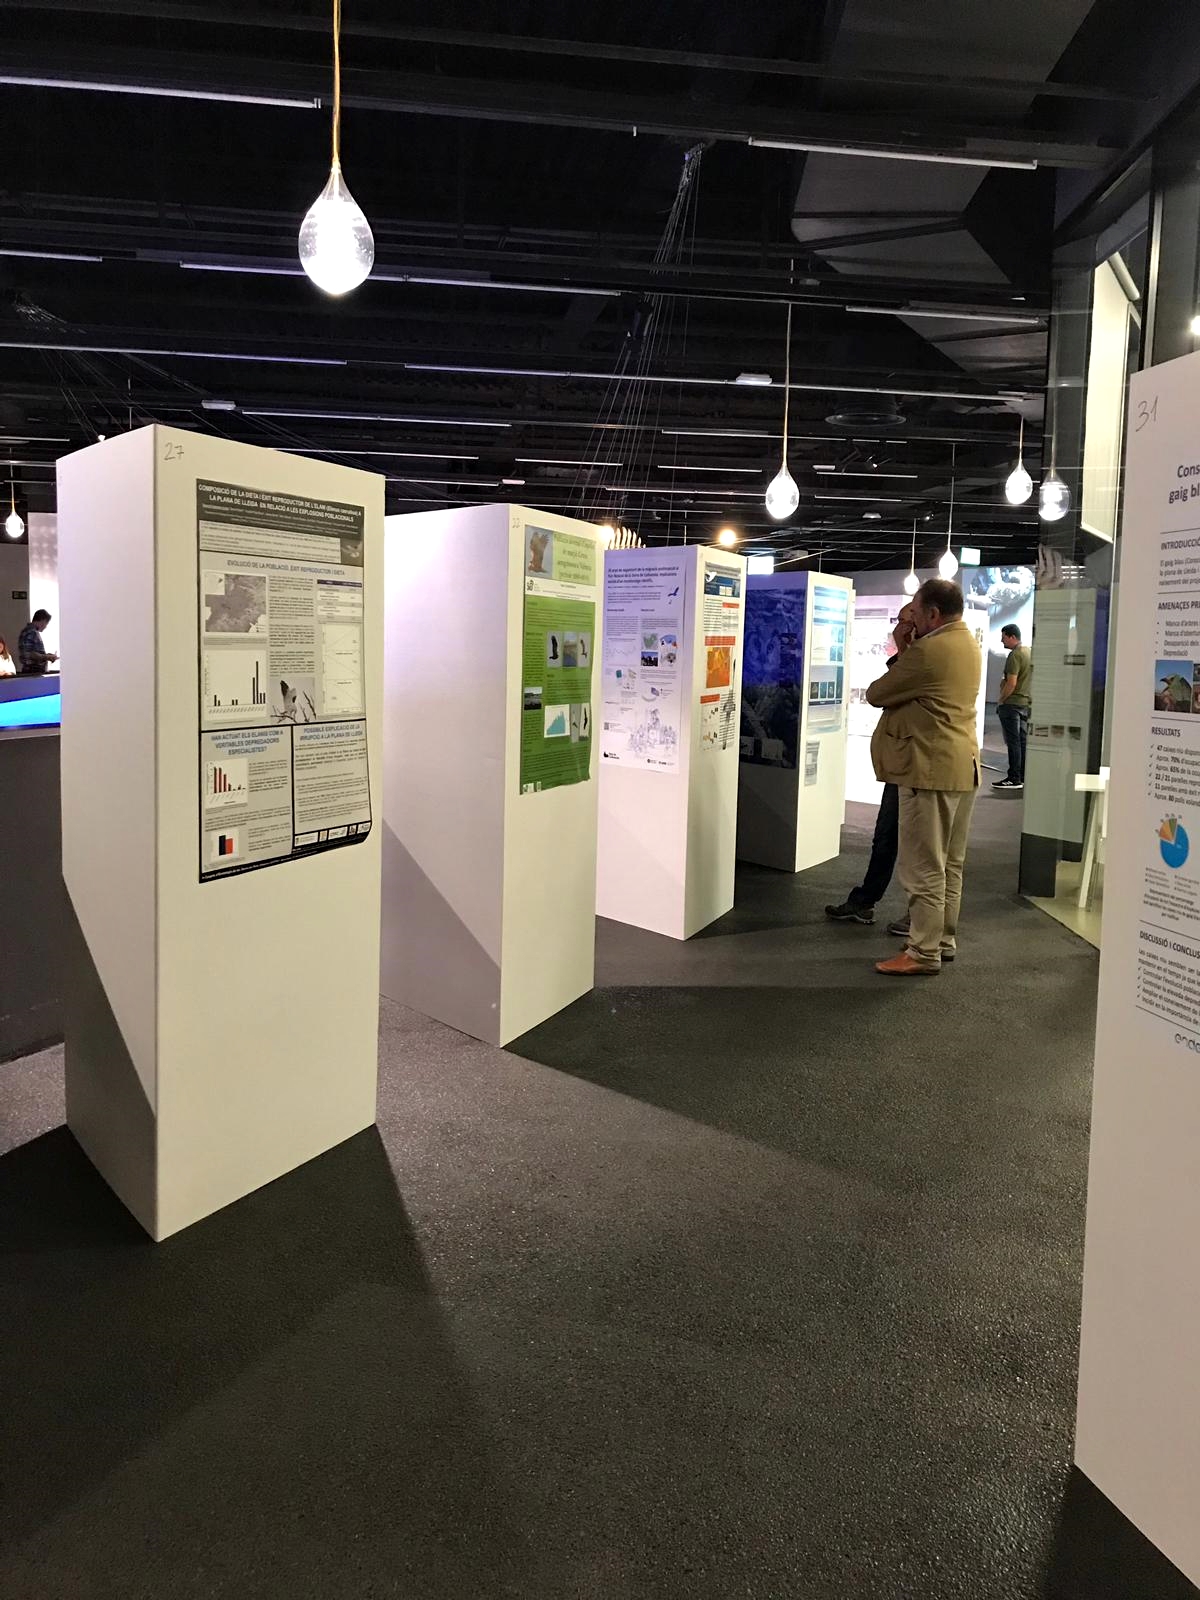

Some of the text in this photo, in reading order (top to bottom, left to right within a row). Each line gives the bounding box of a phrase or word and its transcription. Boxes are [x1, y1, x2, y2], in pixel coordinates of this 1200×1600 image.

[164, 442, 184, 461] 27
[272, 496, 304, 506] REPRODUCTOR
[1169, 486, 1188, 504] gaig
[1158, 601, 1190, 611] AMENAÇES
[1152, 726, 1180, 738] RESULTATS
[1140, 930, 1168, 948] DISCUSSIÓ
